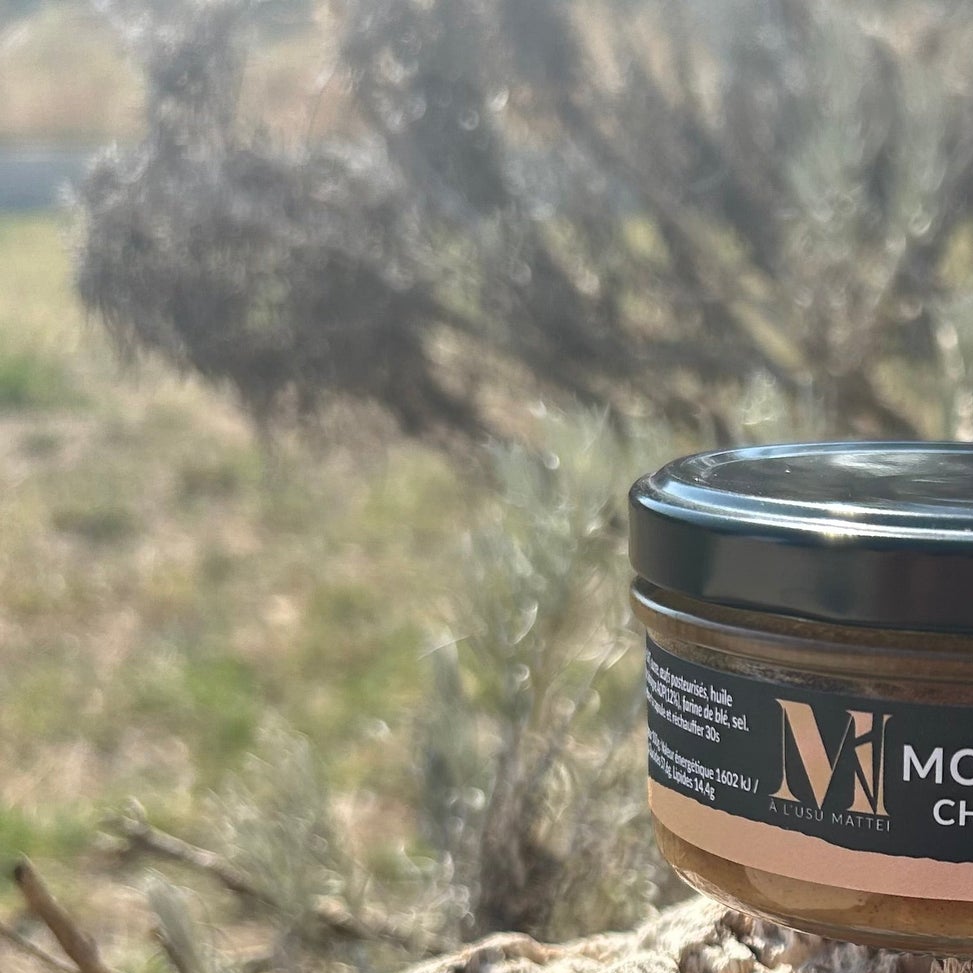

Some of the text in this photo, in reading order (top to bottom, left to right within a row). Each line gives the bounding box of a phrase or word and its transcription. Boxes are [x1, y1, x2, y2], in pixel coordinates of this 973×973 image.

[671, 674, 709, 702] pasteurisés,
[710, 685, 733, 707] huile
[672, 712, 704, 736] réchauffer
[705, 725, 720, 743] 30s
[682, 695, 702, 717] farine
[703, 704, 713, 721] de
[715, 707, 731, 728] blé,
[732, 715, 749, 731] sel.
[672, 765, 693, 789] Lipides
[694, 778, 715, 801] 14,4g
[674, 750, 714, 780] énergétique
[715, 768, 739, 788] 1602
[740, 775, 751, 791] kJ
[753, 779, 759, 794] /
[769, 800, 779, 814] À
[831, 812, 891, 833] MATTEI
